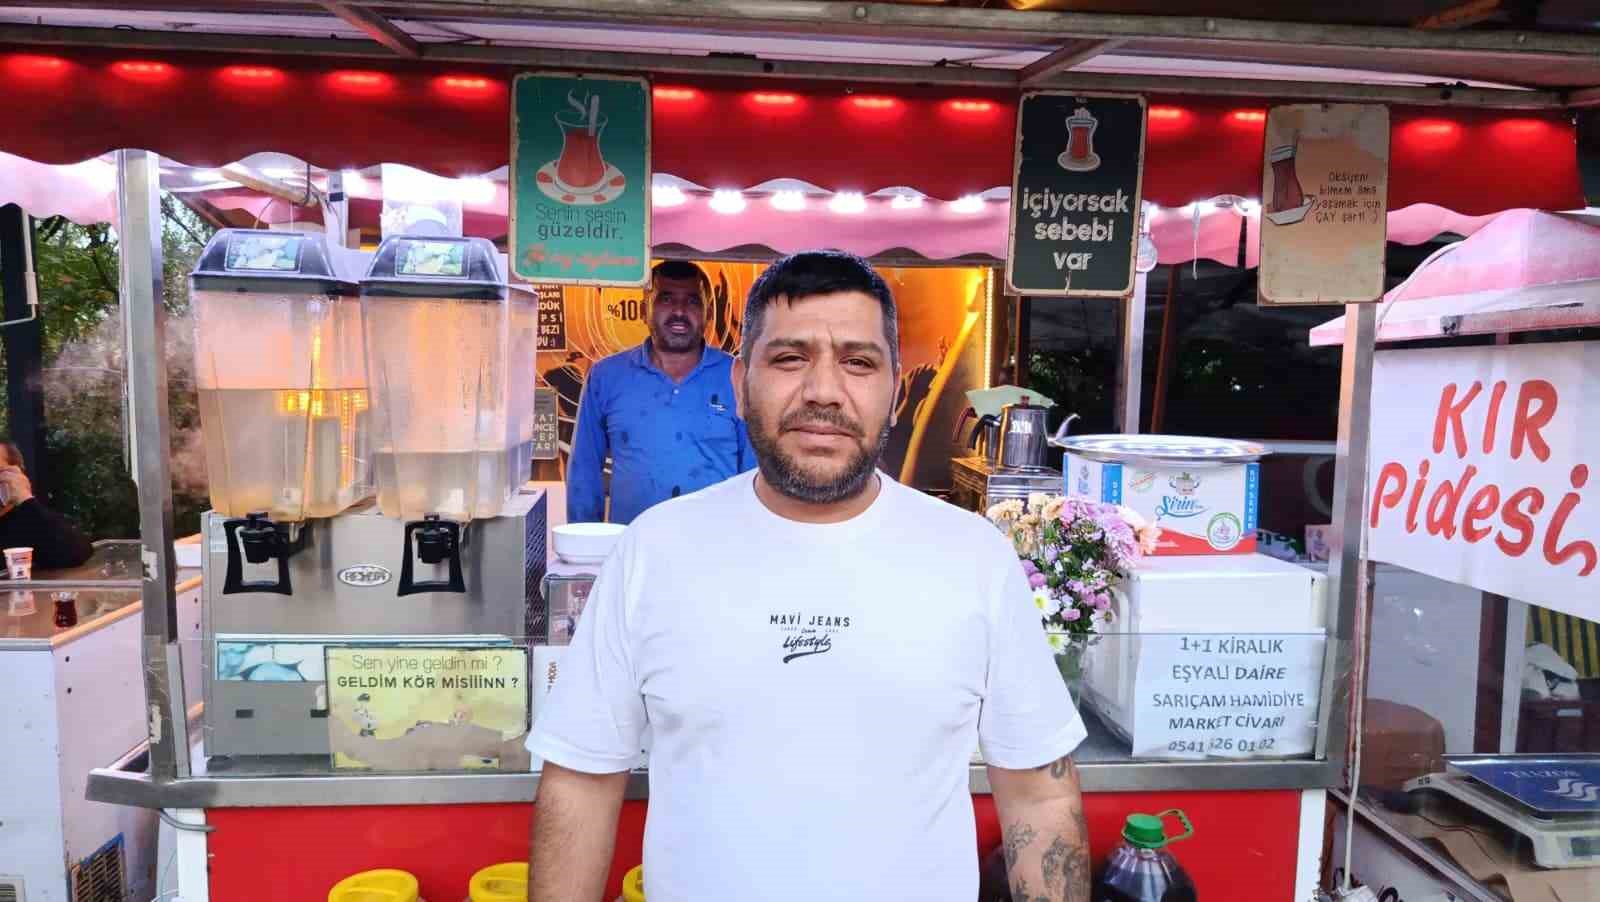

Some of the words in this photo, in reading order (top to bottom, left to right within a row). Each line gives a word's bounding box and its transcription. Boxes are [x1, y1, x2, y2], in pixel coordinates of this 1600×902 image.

[1023, 187, 1129, 218] içiyorsak
[536, 203, 580, 223] Senin
[585, 206, 626, 224] sesin
[538, 222, 624, 241] güzeldir.
[1034, 217, 1115, 242] sebebi
[1053, 251, 1093, 271] var
[1433, 379, 1558, 462] KIR
[1370, 459, 1598, 577] Pidesi
[808, 615, 850, 627] JEANS
[1180, 636, 1212, 653] 1+1
[1218, 636, 1284, 654] KİRALIK
[353, 655, 382, 670] Sen
[387, 656, 417, 673] yine
[423, 655, 466, 673] geldin
[471, 656, 488, 670] mi
[1172, 665, 1229, 683] EŞYALI
[1235, 664, 1287, 680] DAİRE
[337, 674, 397, 688] GELDİM
[403, 675, 435, 689] KÖR
[511, 677, 519, 689] ?
[1152, 693, 1226, 710] SARIÇAM
[1230, 690, 1305, 707] HAMİDİYE
[1168, 715, 1231, 730] MARKET
[1235, 713, 1285, 729] CİVARI
[1168, 740, 1205, 753] 0541
